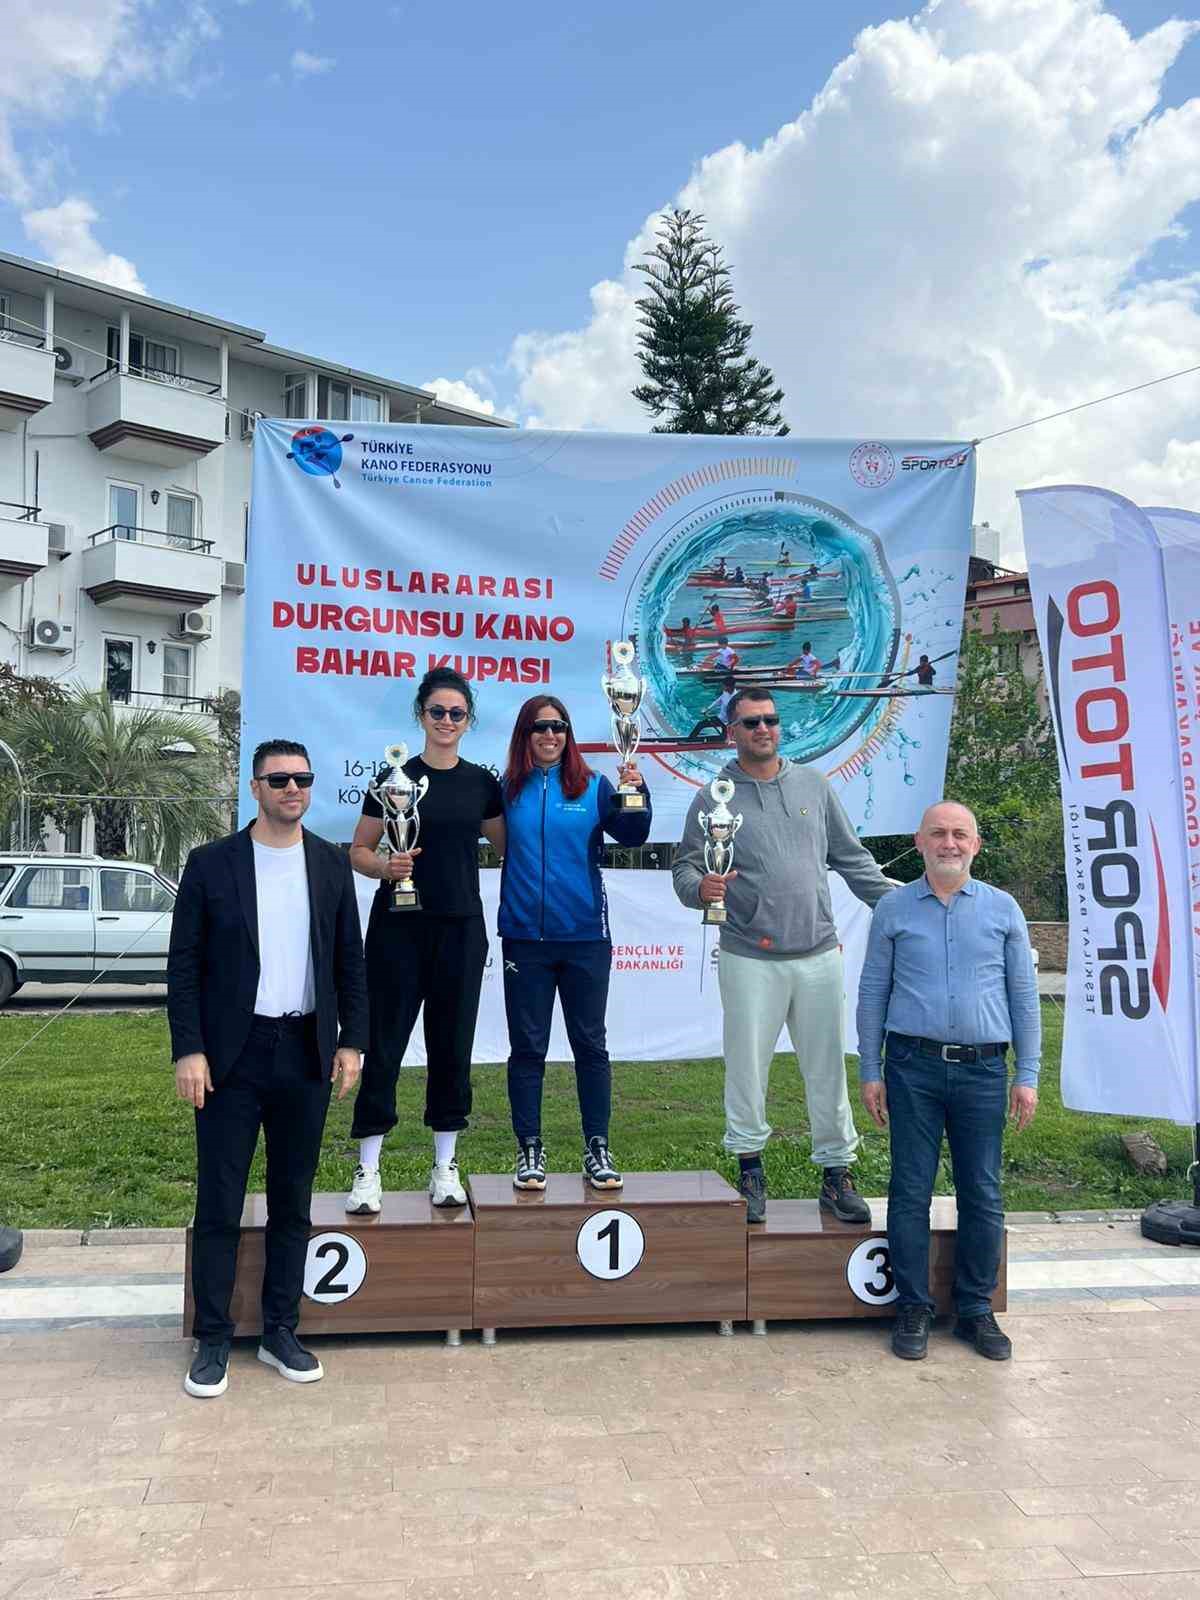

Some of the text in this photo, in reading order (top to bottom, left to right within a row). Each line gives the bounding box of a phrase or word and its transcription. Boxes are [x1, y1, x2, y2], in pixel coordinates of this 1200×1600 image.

[361, 439, 414, 454] TÜRKİYE
[361, 459, 492, 475] KANO FEDERASYONU
[361, 473, 492, 487] Türkiye Canoe Federation
[296, 563, 553, 600] ULUSLARARASI
[272, 601, 575, 643] DURGUNSU KANO
[296, 646, 551, 684] BAHAR KUPASI
[616, 958, 683, 970] BAKANLIĞI
[668, 945, 685, 956] VE
[597, 1220, 620, 1271] 1
[313, 1241, 350, 1295] 2
[864, 1247, 896, 1297] 3
